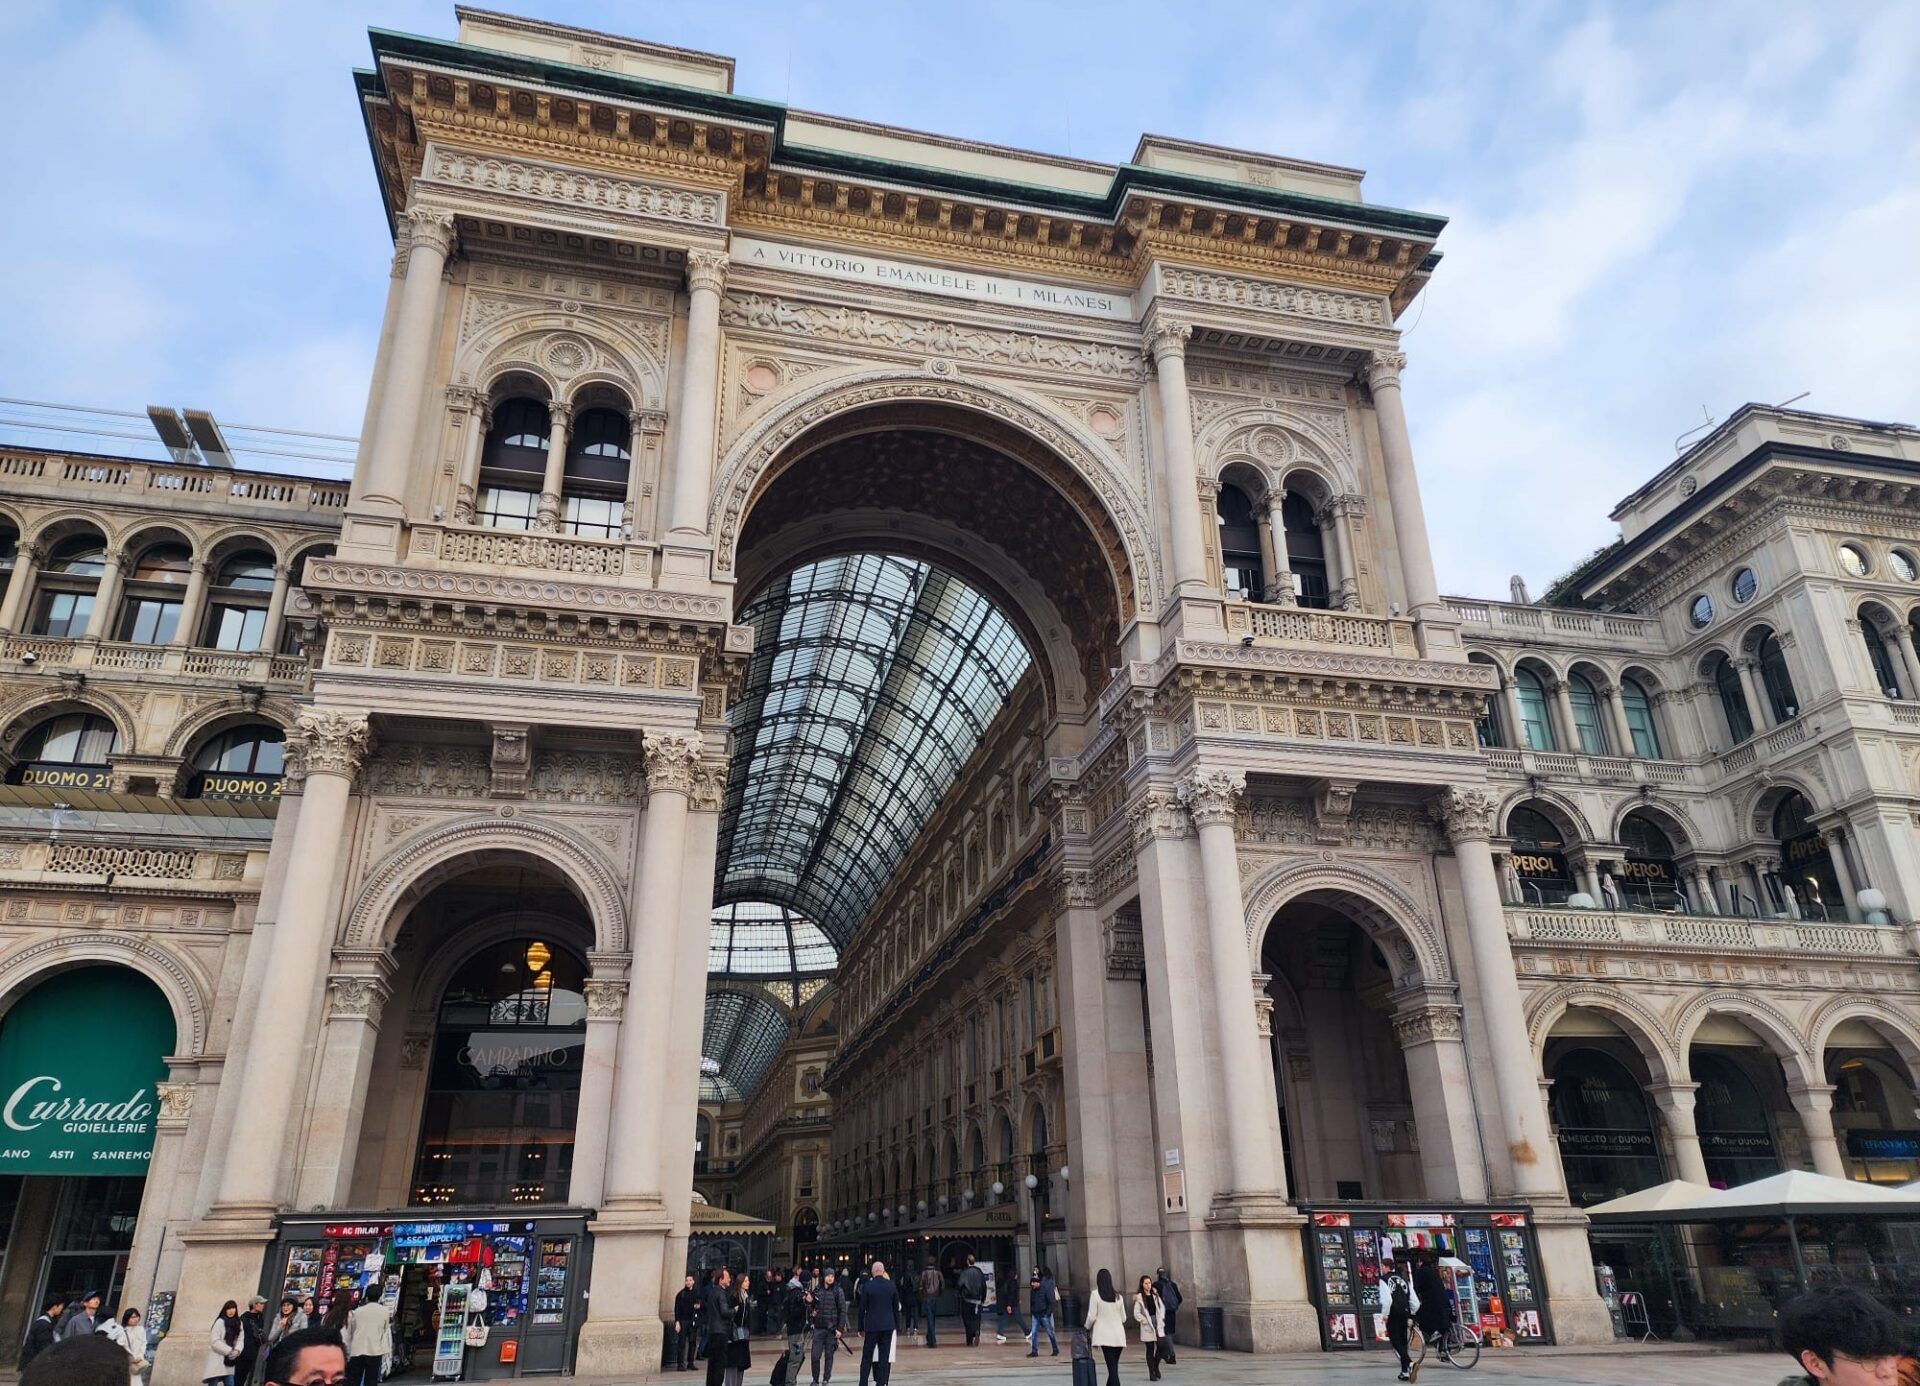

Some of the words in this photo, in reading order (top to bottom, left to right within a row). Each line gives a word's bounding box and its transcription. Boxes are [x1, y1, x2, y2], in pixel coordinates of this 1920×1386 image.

[753, 247, 765, 260] A
[778, 250, 865, 274] VITTORIO
[876, 265, 976, 292] EMANUELE
[1032, 289, 1113, 312] MILANESI
[22, 769, 90, 787] DUOMO
[92, 774, 111, 788] 21
[202, 778, 267, 794] DUOMO
[1623, 863, 1669, 879] PEROL
[456, 1046, 568, 1067] CAMPARINO
[3, 1076, 152, 1131] Currado
[63, 1123, 147, 1133] GIOIELLERIE
[1567, 1134, 1607, 1144] MERCATO
[1618, 1135, 1651, 1144] DUOMO
[1738, 1137, 1769, 1146] DUOMO
[0, 1149, 31, 1159] ANO
[49, 1150, 74, 1160] ASTI
[92, 1150, 152, 1160] SANREMO
[342, 1227, 354, 1235] AC
[355, 1226, 379, 1235] MILAN
[493, 1223, 510, 1233] INTER
[407, 1236, 423, 1244] SSC
[424, 1234, 453, 1243] NAPOLI
